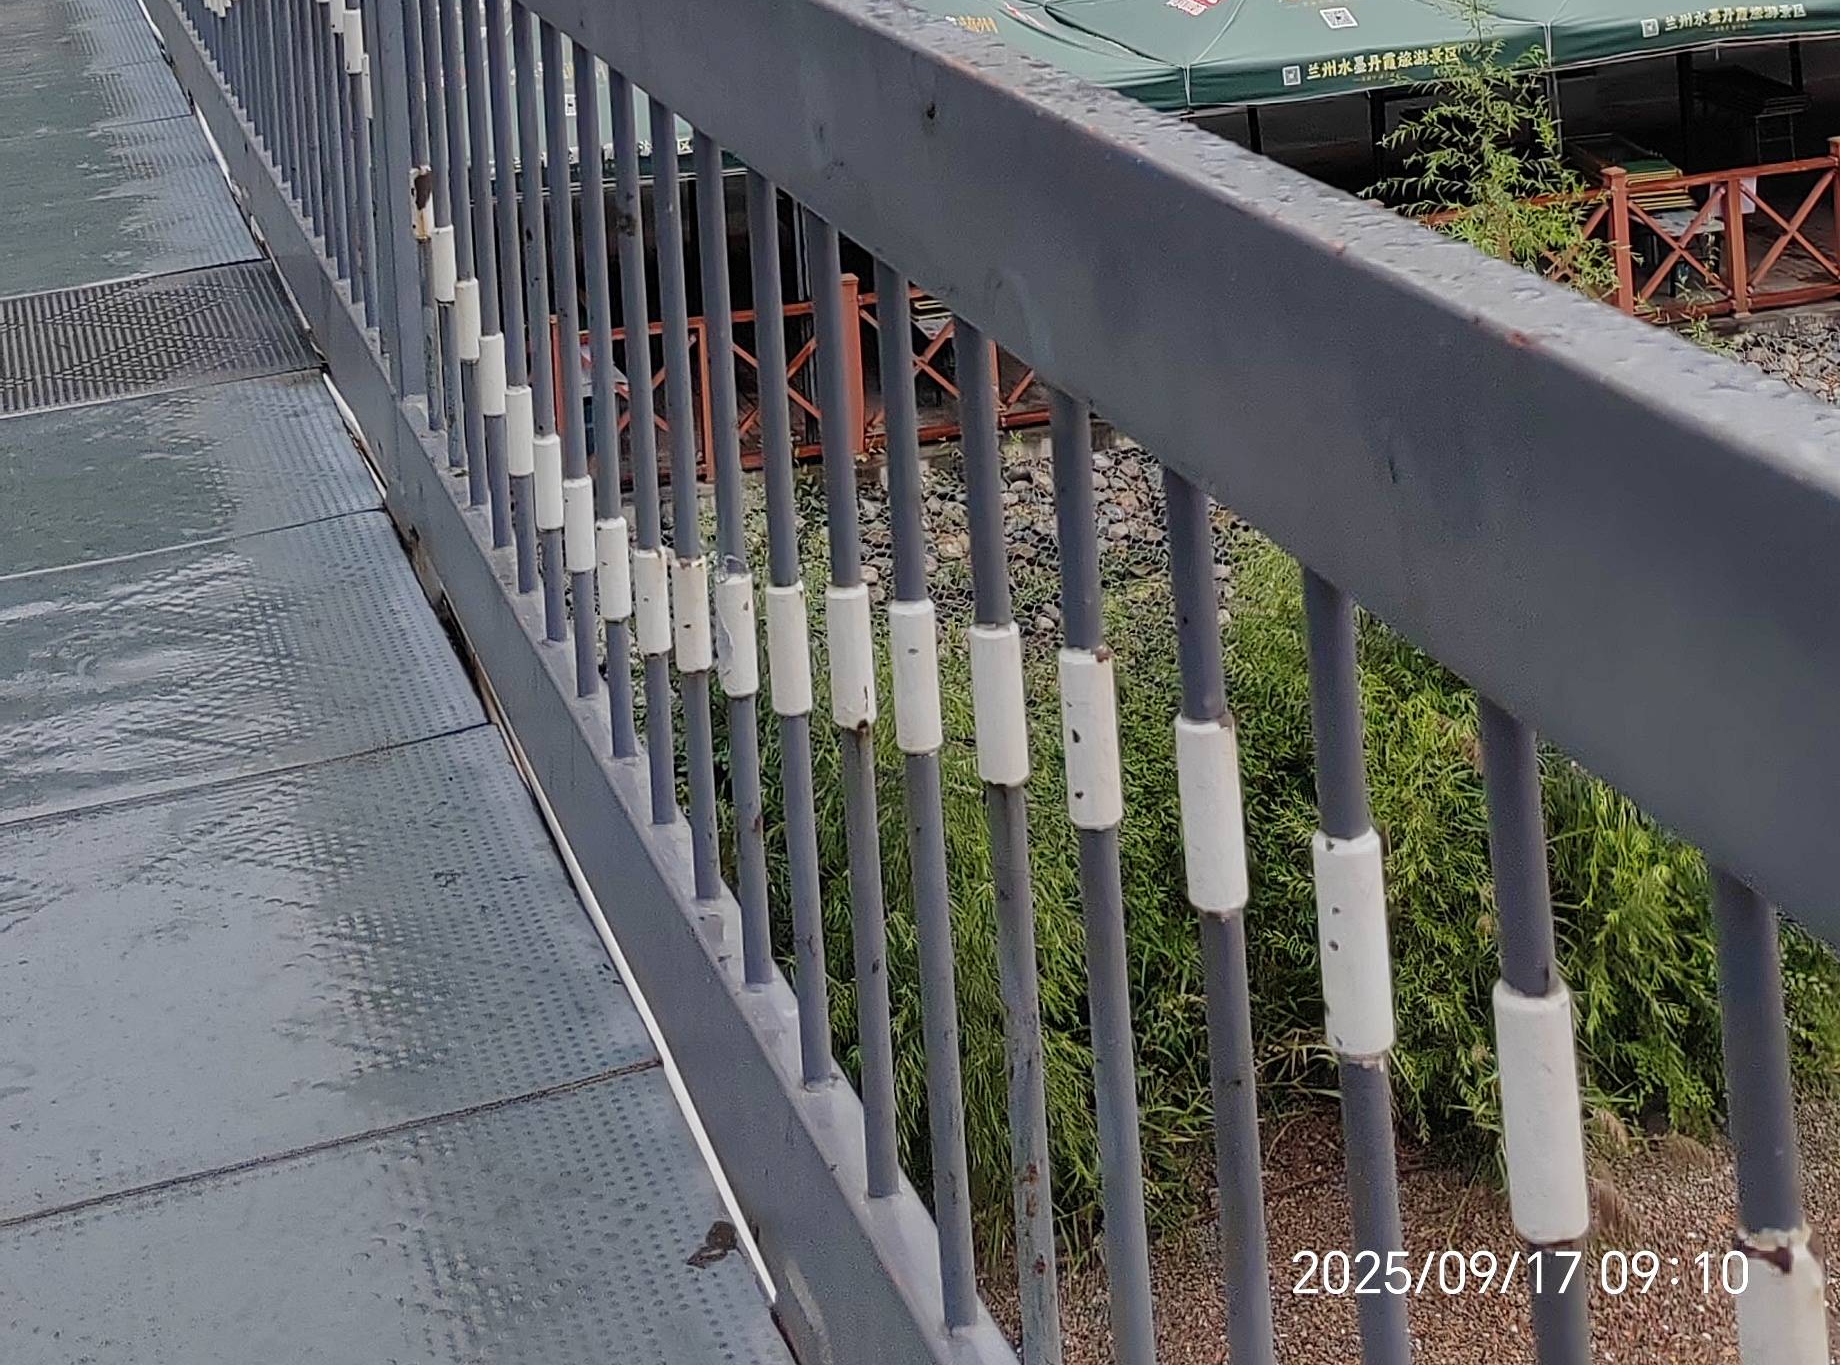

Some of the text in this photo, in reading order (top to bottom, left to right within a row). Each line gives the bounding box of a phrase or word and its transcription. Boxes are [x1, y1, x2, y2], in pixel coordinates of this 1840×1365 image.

[1306, 45, 1460, 80] 兰州水墨丹霞旅游景区
